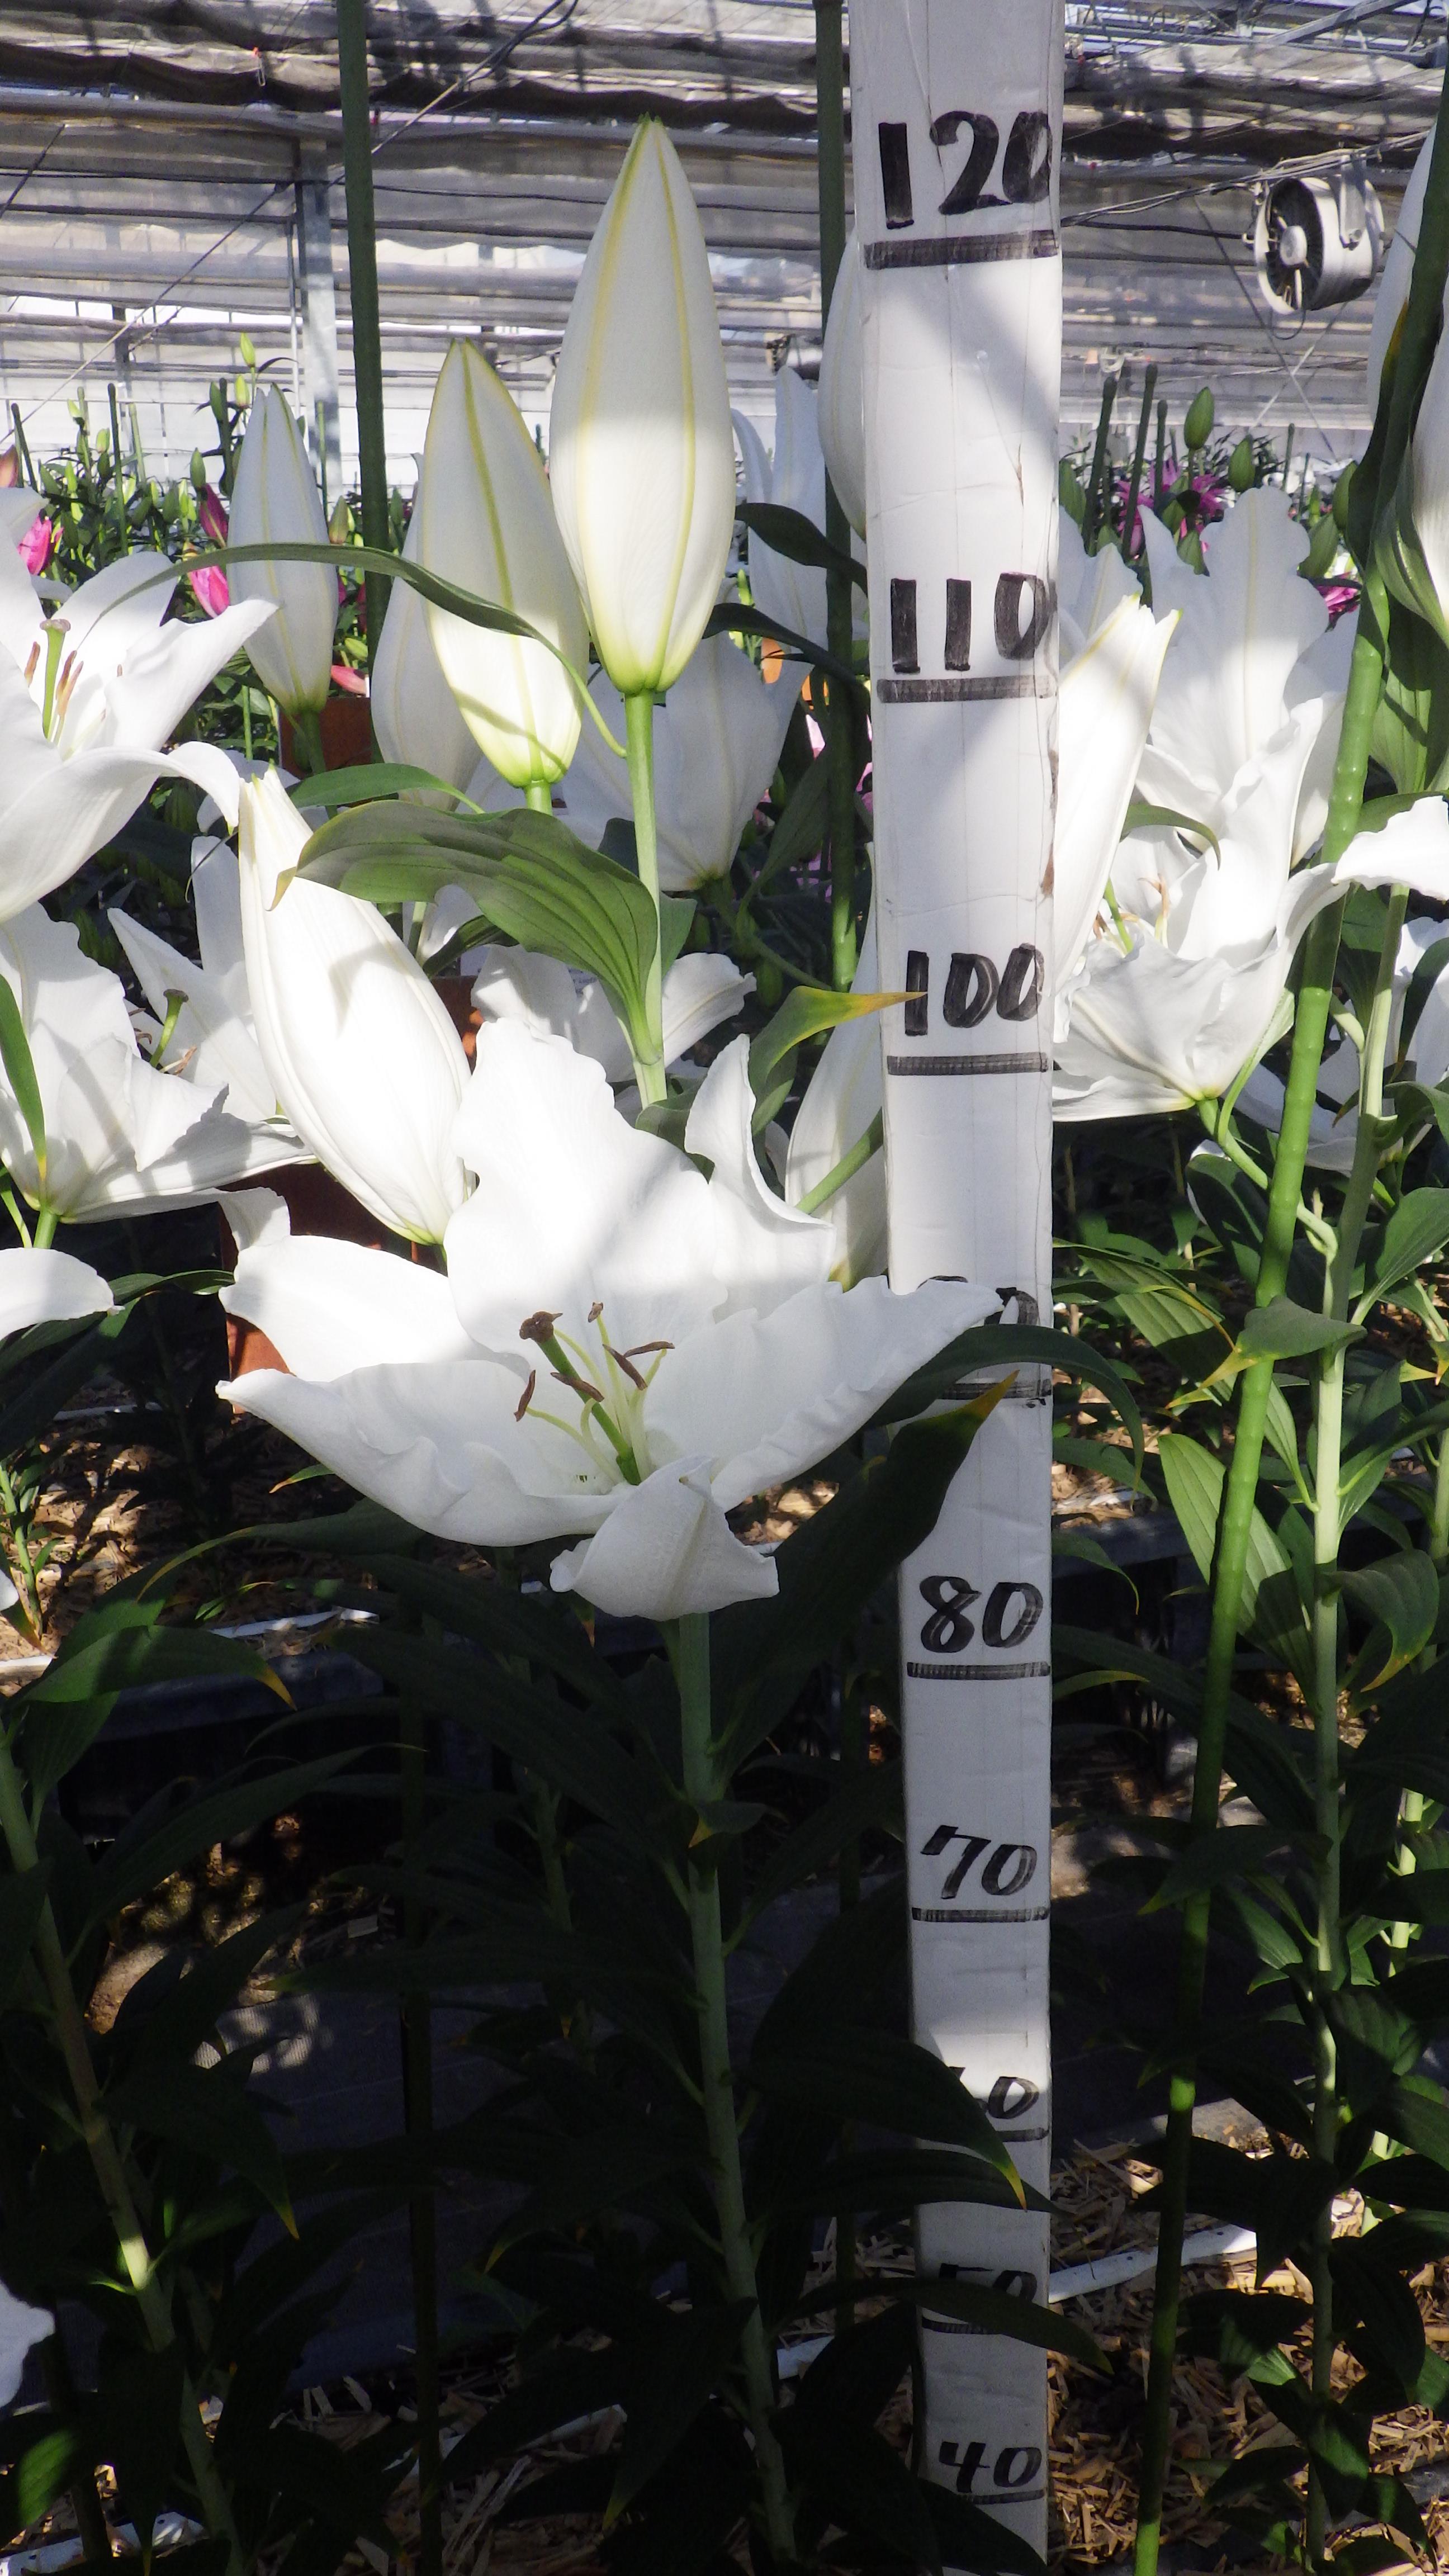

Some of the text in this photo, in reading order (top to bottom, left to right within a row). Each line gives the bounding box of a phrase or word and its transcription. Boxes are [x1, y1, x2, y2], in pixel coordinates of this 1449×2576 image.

[878, 111, 1053, 230] 120
[891, 571, 1052, 674] 110
[905, 943, 1044, 1036] 100
[919, 1575, 1044, 1653] 80
[920, 1825, 1037, 1900] 70
[939, 2441, 1042, 2493] 40
